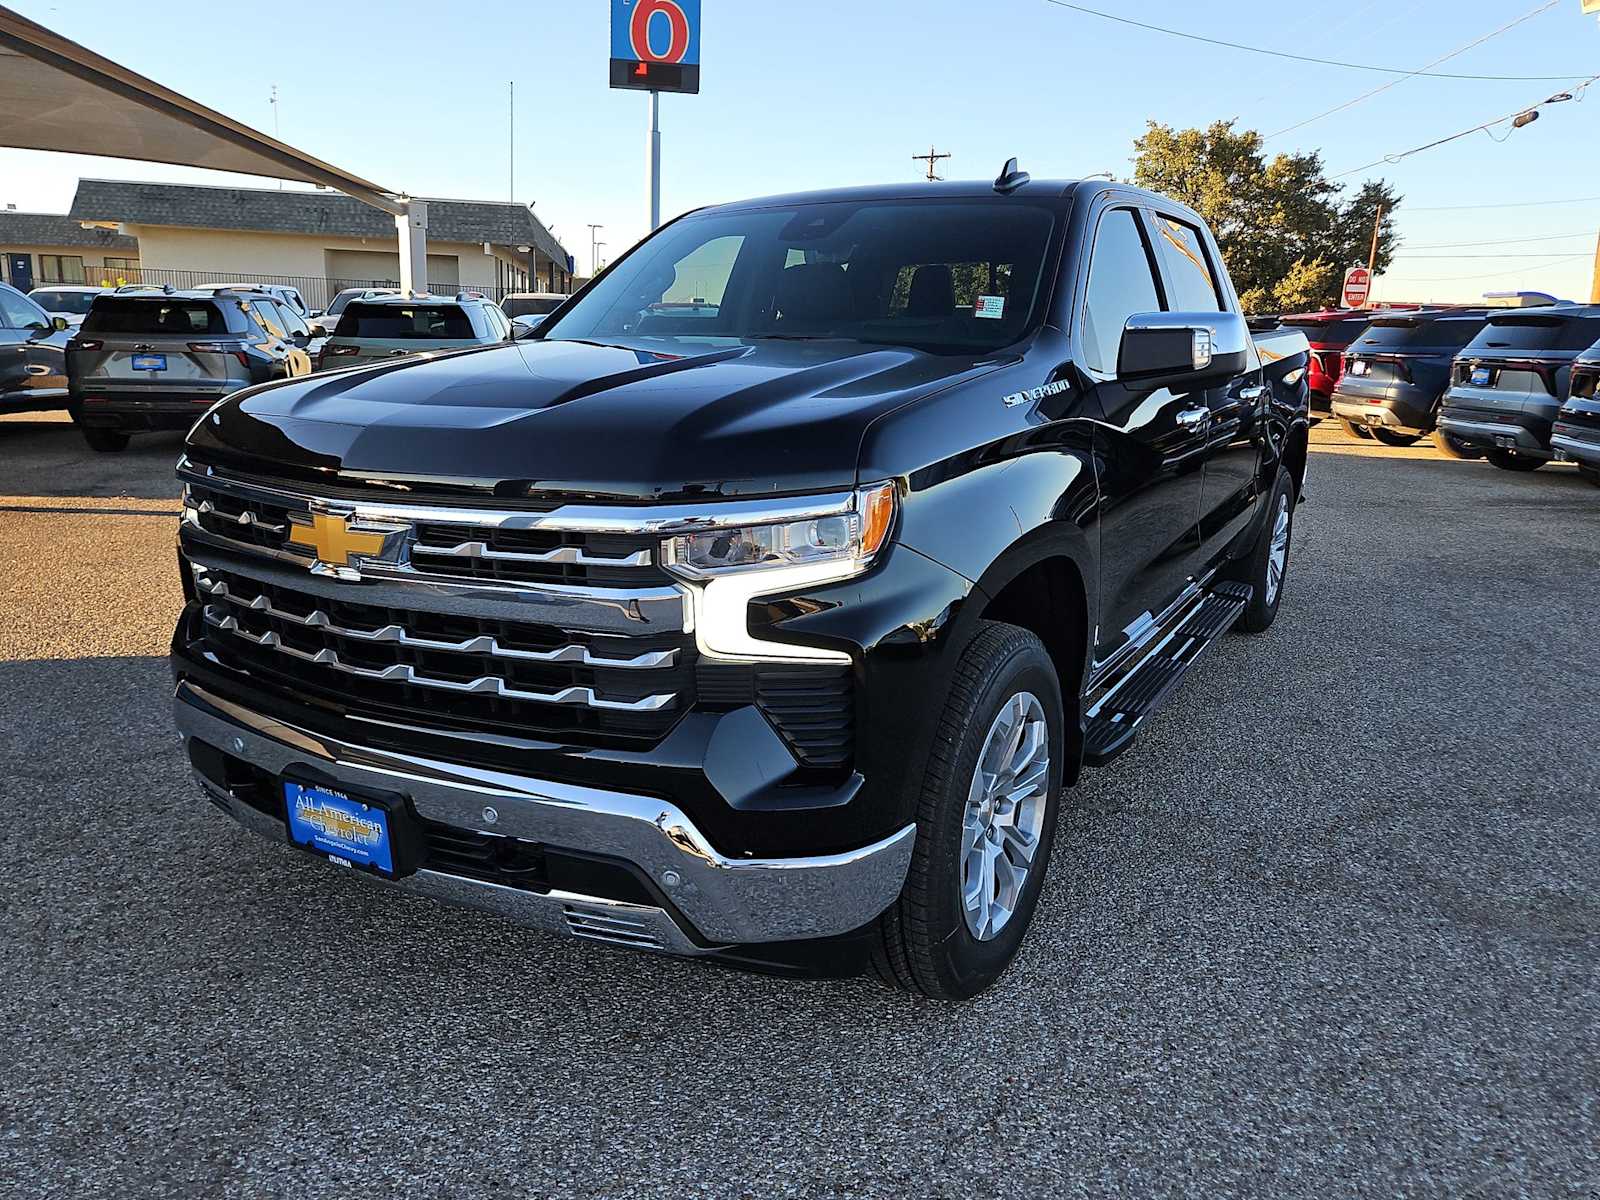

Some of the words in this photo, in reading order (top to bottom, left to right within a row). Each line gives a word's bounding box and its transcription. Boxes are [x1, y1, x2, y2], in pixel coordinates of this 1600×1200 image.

[1347, 293, 1364, 301] ENTER
[1002, 379, 1071, 408] SILVERADO
[315, 785, 333, 797] SINCE
[296, 795, 314, 813] All
[319, 802, 382, 833] American
